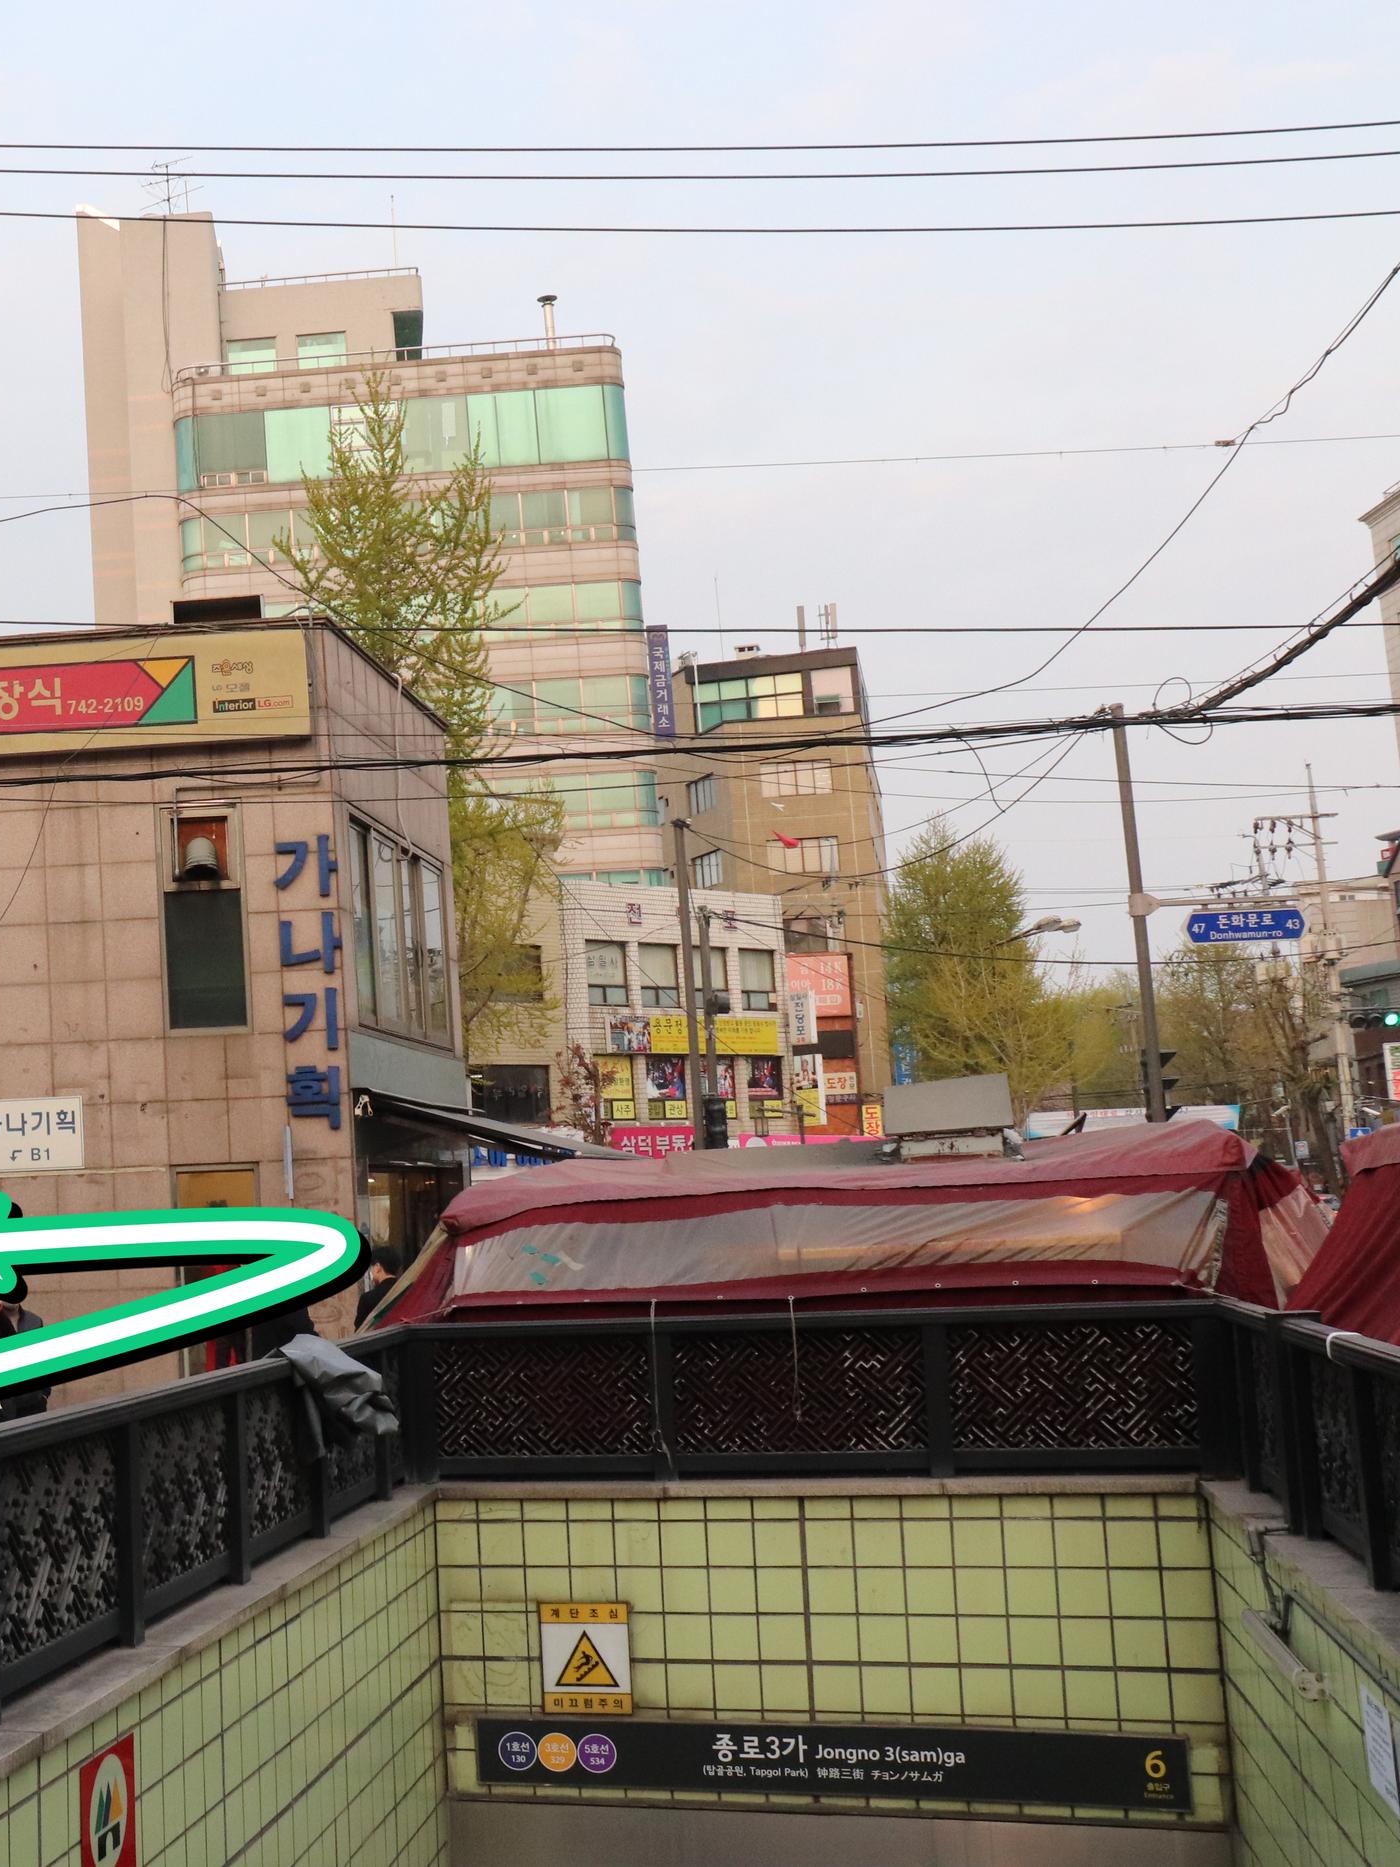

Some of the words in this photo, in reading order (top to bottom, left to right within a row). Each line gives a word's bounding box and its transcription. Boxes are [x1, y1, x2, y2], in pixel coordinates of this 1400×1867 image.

[652, 646, 670, 728] 국제금거래소
[66, 696, 145, 716] 742-2109
[1192, 923, 1206, 934] 47
[1217, 913, 1275, 929] 돈화문로
[1286, 919, 1300, 930] 43
[1210, 929, 1283, 940] Donhwamun-ro
[273, 834, 342, 1130] 가나기획
[826, 1076, 847, 1090] 도장
[30, 1148, 50, 1161] B1
[506, 1741, 530, 1752] 1호선
[544, 1742, 569, 1753] 3호선
[584, 1744, 609, 1755] 5호선
[712, 1734, 807, 1763] 종로3가
[815, 1744, 880, 1762] Jongno
[884, 1746, 966, 1767] 3(sam)ga
[511, 1755, 526, 1763] 130
[590, 1757, 605, 1766] 534
[1145, 1750, 1166, 1778] 6
[703, 1765, 747, 1777] (탑골공원,
[749, 1767, 782, 1779] Tapgol
[784, 1767, 809, 1779] Park)
[816, 1767, 864, 1780] 钟路三街
[871, 1770, 944, 1783] チョンノサムガ
